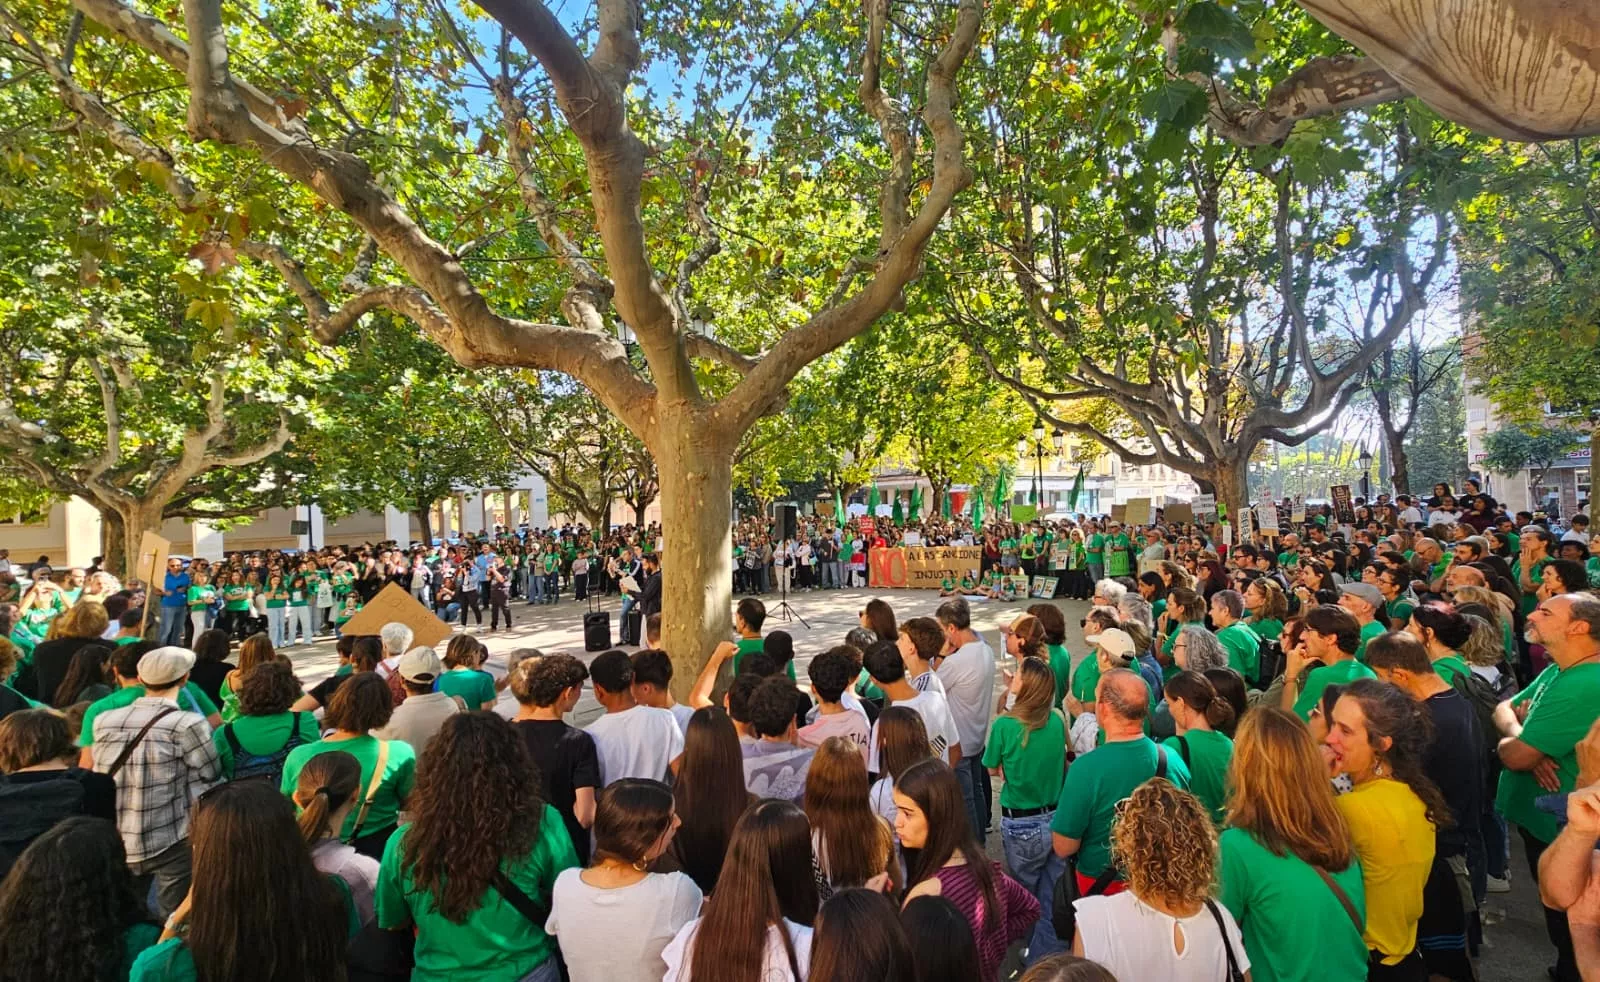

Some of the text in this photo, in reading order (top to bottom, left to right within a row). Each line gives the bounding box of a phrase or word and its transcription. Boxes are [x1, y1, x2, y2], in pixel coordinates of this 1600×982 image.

[909, 551, 915, 561] A
[917, 551, 935, 561] LAS
[869, 549, 906, 587] NO
[912, 569, 957, 579] INJUSAS
[844, 732, 867, 746] TIA
